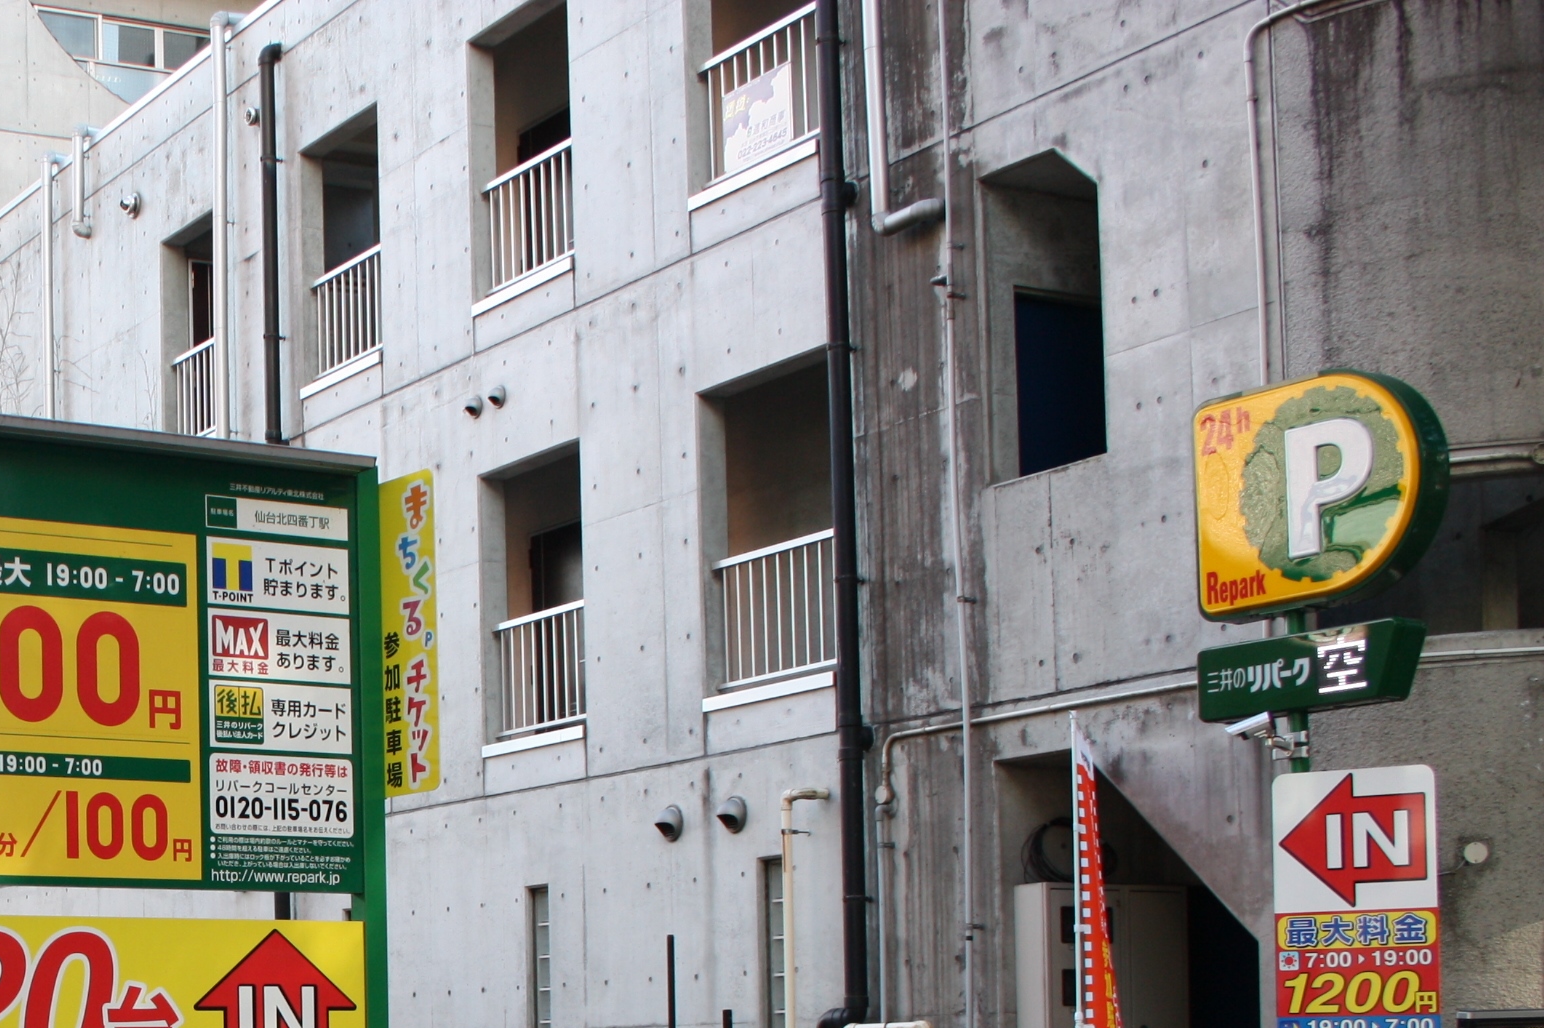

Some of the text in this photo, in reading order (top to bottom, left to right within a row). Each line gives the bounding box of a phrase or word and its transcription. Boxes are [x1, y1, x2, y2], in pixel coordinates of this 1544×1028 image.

[1285, 418, 1373, 560] P
[254, 510, 330, 529] 仙台北四番丁駅
[47, 562, 108, 589] 19:00
[131, 570, 180, 595] 7:00
[265, 558, 338, 579] Tポイント
[263, 578, 346, 602] 貯まります。
[1206, 570, 1267, 606] Repark
[215, 618, 265, 657] MAX
[276, 629, 340, 651] 最大料金
[212, 659, 269, 675] 最大料金
[276, 652, 344, 673] あります。
[1316, 636, 1368, 694] 空
[1206, 657, 1311, 694] 三井のリパーク
[217, 689, 262, 716] 後払
[271, 699, 346, 720] 専用カード
[384, 631, 403, 788] 参加駐車場
[216, 720, 263, 730] 三井のリパーク
[272, 721, 346, 742] クレジット
[0, 754, 46, 774] 19:00
[65, 757, 103, 776] 7:00
[215, 758, 348, 778] 故障・領収書の発行等は
[215, 779, 348, 797] リパークコールセンター
[215, 795, 348, 822] 0120-115-076
[1325, 809, 1410, 870] IN
[211, 869, 340, 885] http://www.repark.jp
[1286, 914, 1428, 948] 最大料金
[1305, 949, 1433, 968] 7:00 19:00
[1282, 970, 1437, 1014] 1200円
